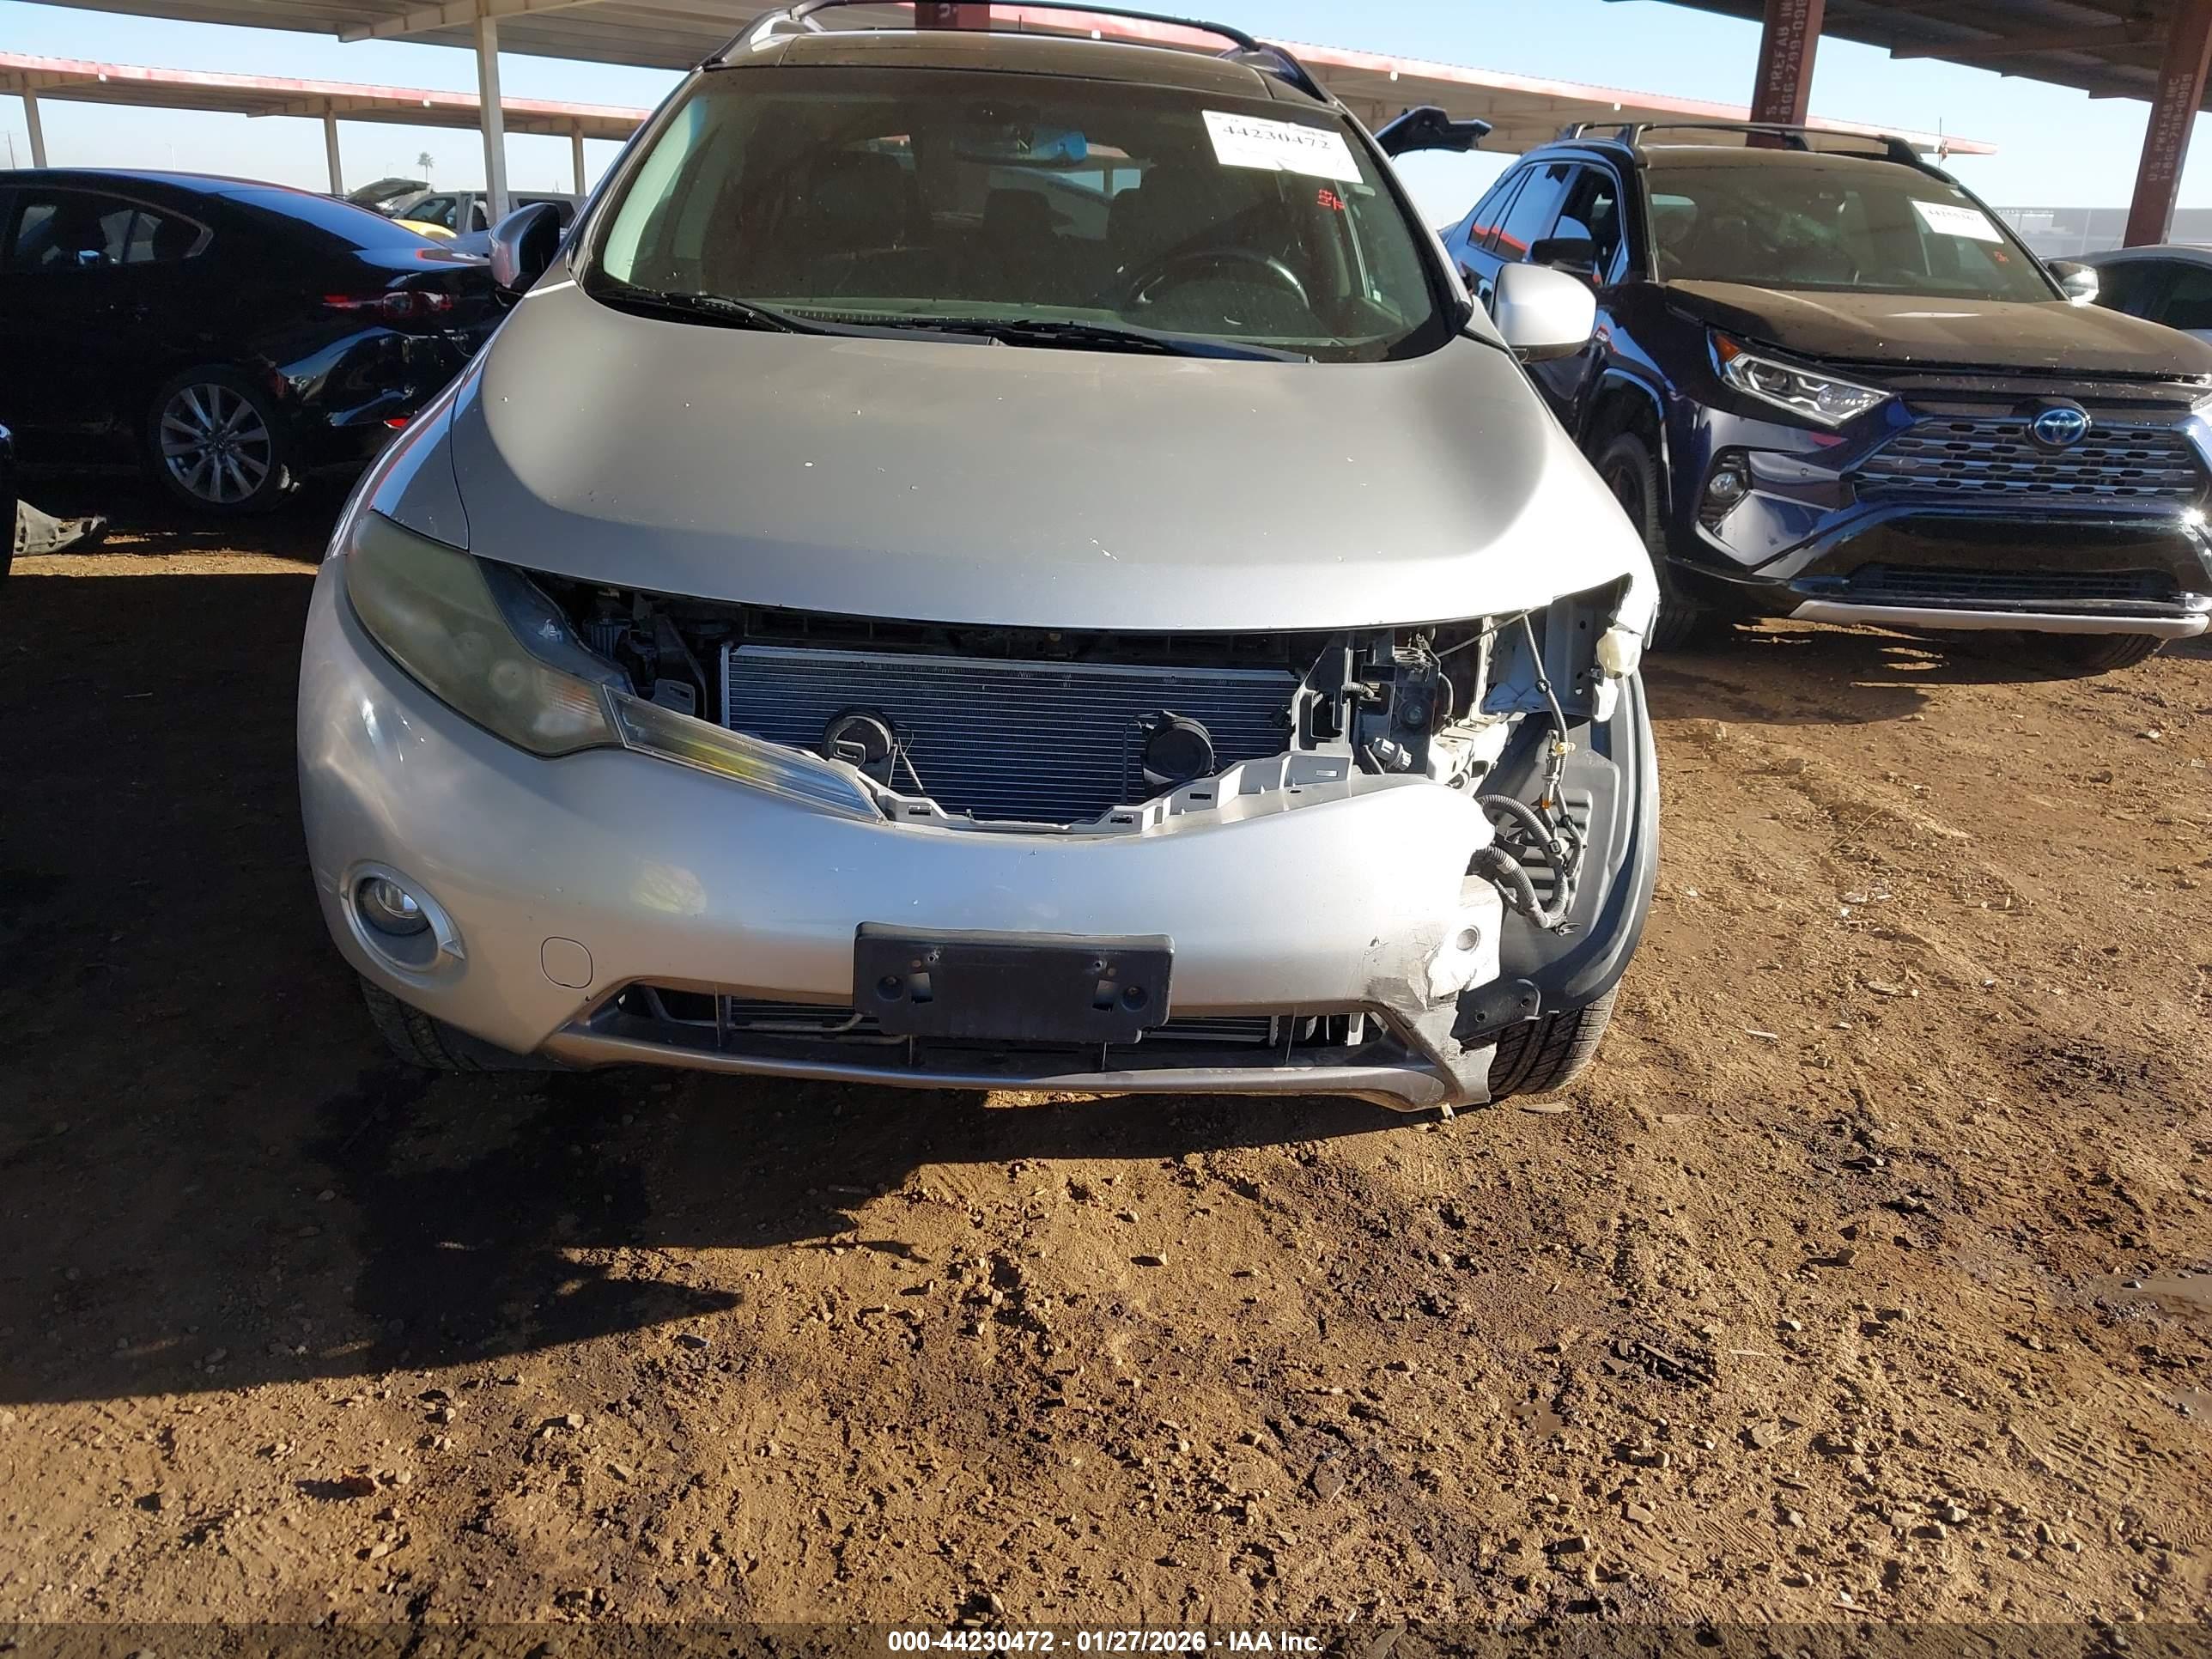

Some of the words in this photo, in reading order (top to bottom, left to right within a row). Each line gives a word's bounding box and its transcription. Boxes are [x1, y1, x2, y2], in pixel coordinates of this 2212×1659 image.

[1770, 26, 1790, 92] PREFAB
[1780, 0, 1793, 17] IN
[1223, 125, 1331, 149] 44230472
